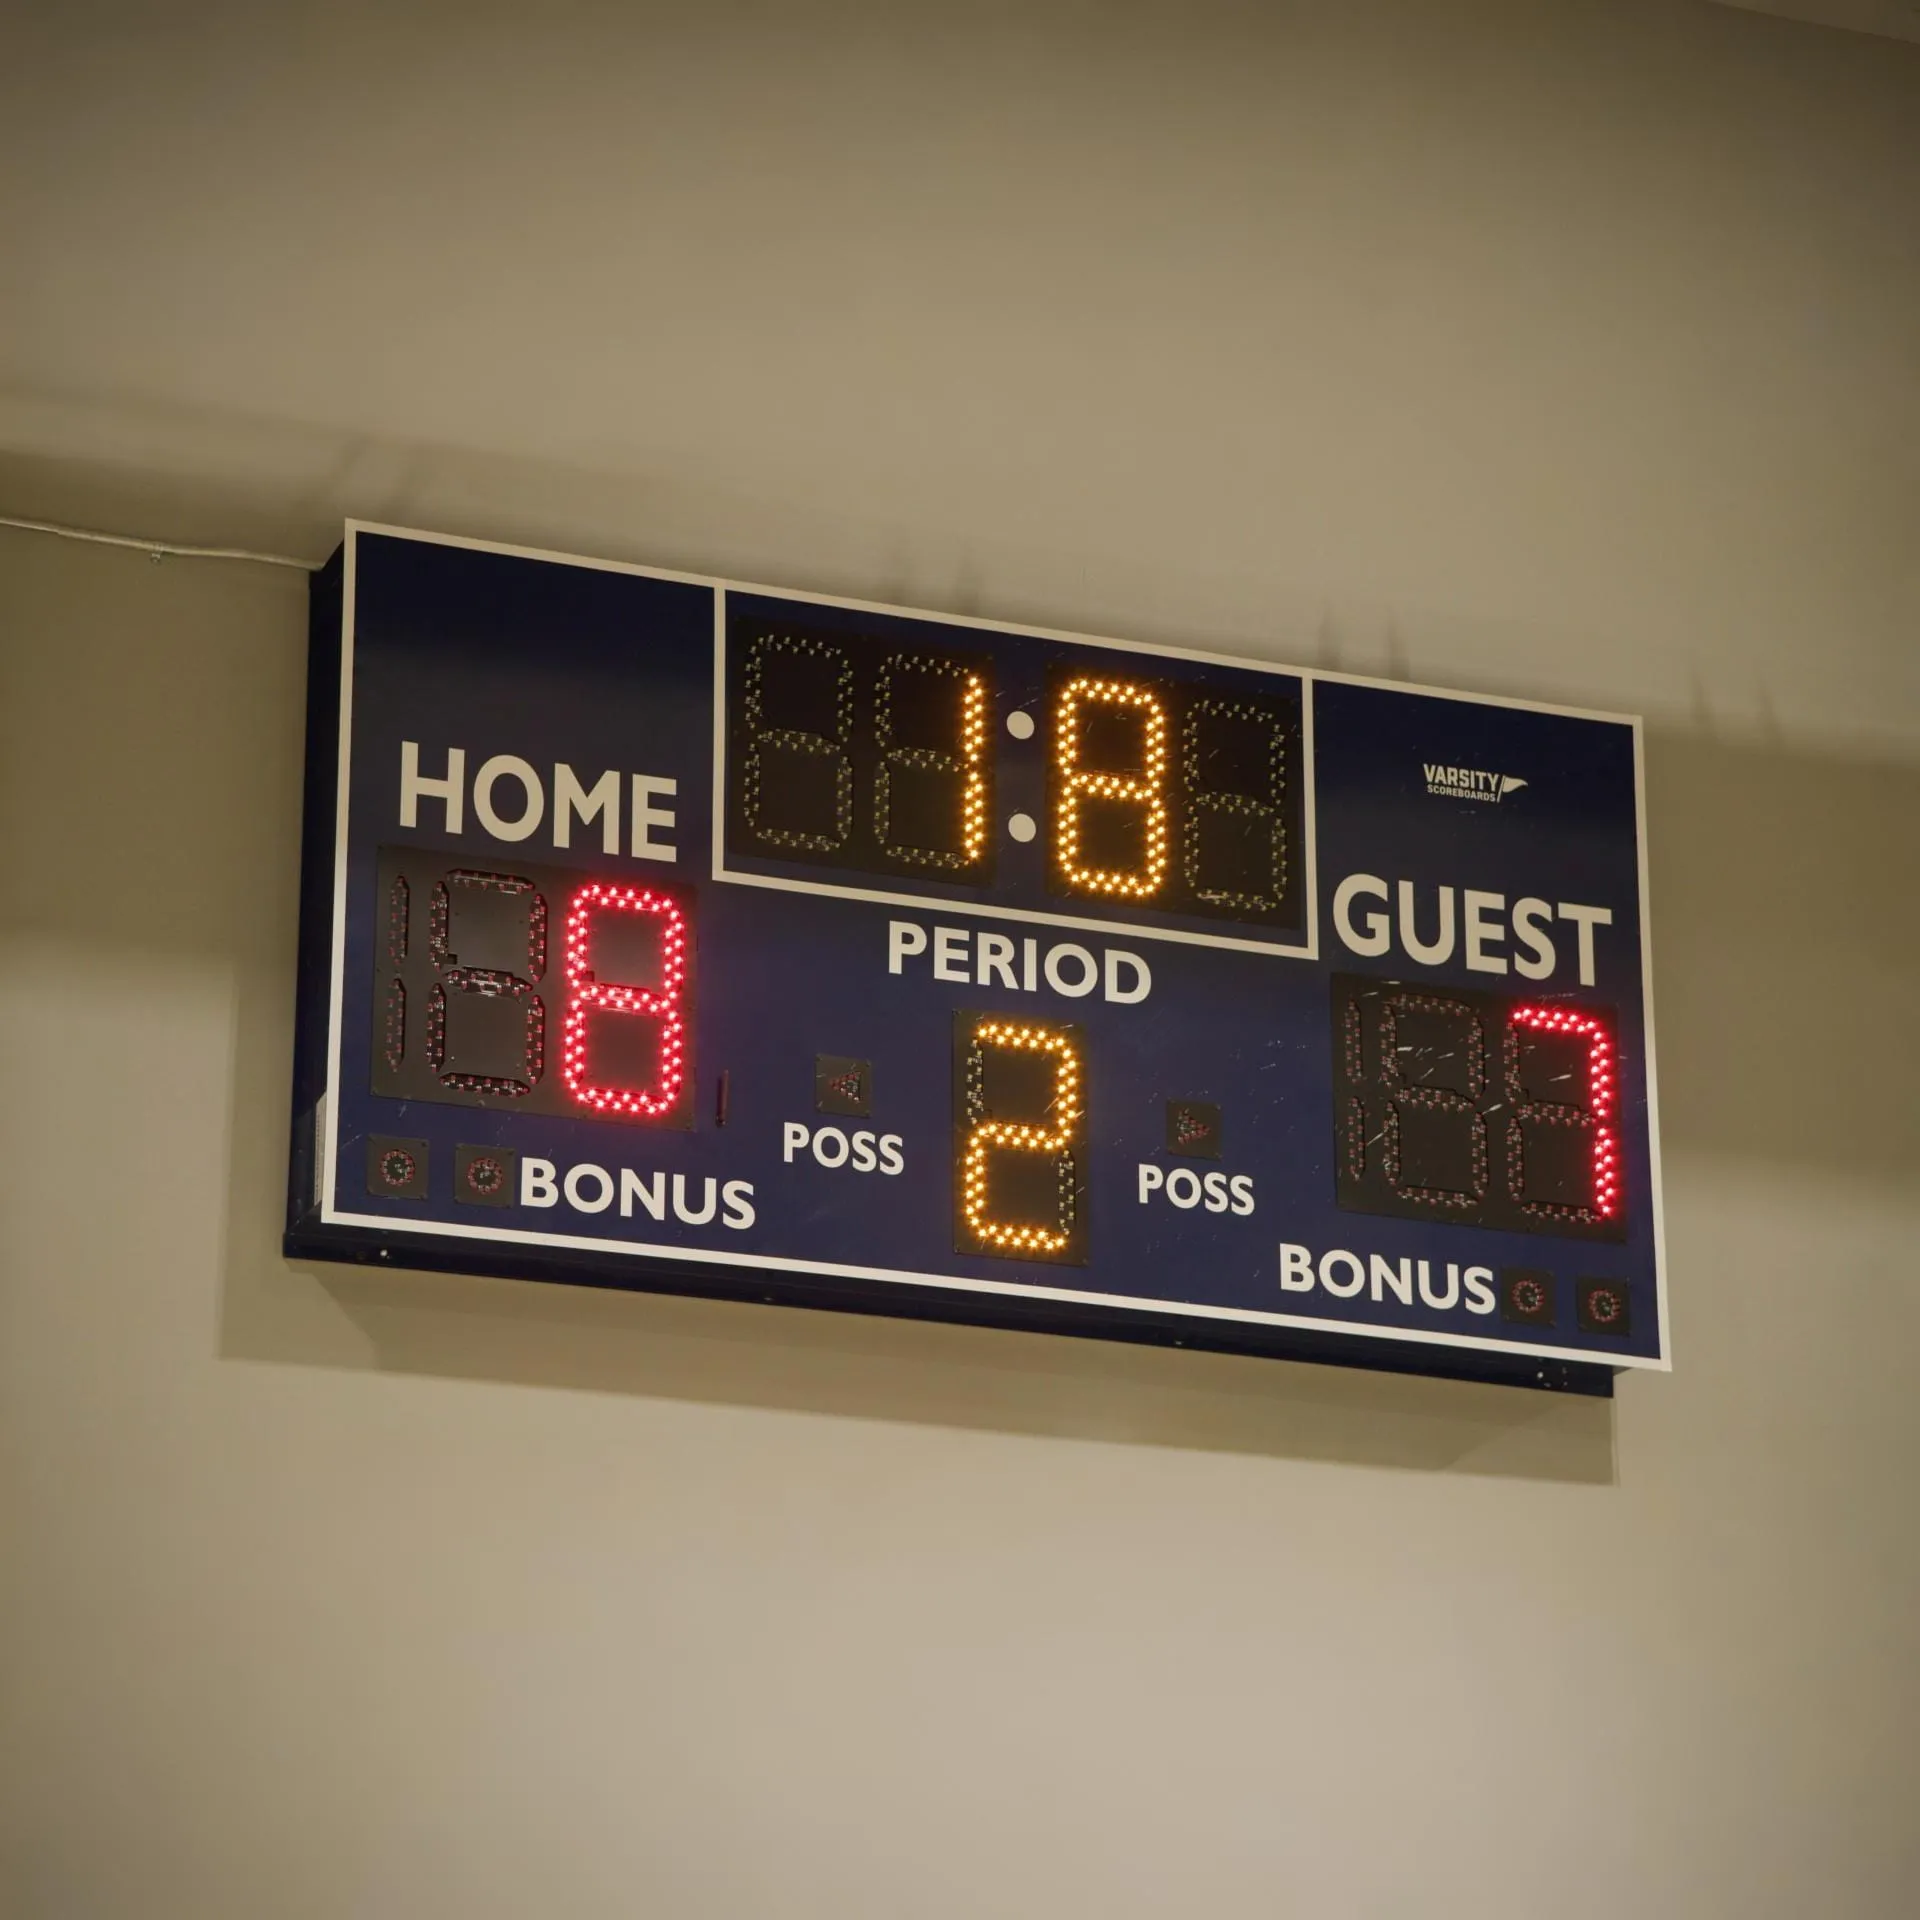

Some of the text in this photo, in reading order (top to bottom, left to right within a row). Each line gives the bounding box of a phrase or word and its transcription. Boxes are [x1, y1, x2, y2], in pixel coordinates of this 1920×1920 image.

[399, 741, 677, 863] HOME
[1423, 763, 1499, 792] VARSITY
[1427, 784, 1496, 802] SCOREBOARDS
[888, 920, 1152, 1004] PERIOD
[1333, 873, 1612, 987] GUEST
[564, 884, 685, 1115] 8
[783, 1121, 905, 1176] POSS
[962, 1021, 1081, 1254] 2
[1510, 1006, 1621, 1218] 7
[520, 1156, 756, 1230] BONUS
[1138, 1163, 1255, 1216] POSS
[1279, 1242, 1496, 1315] BONUS
